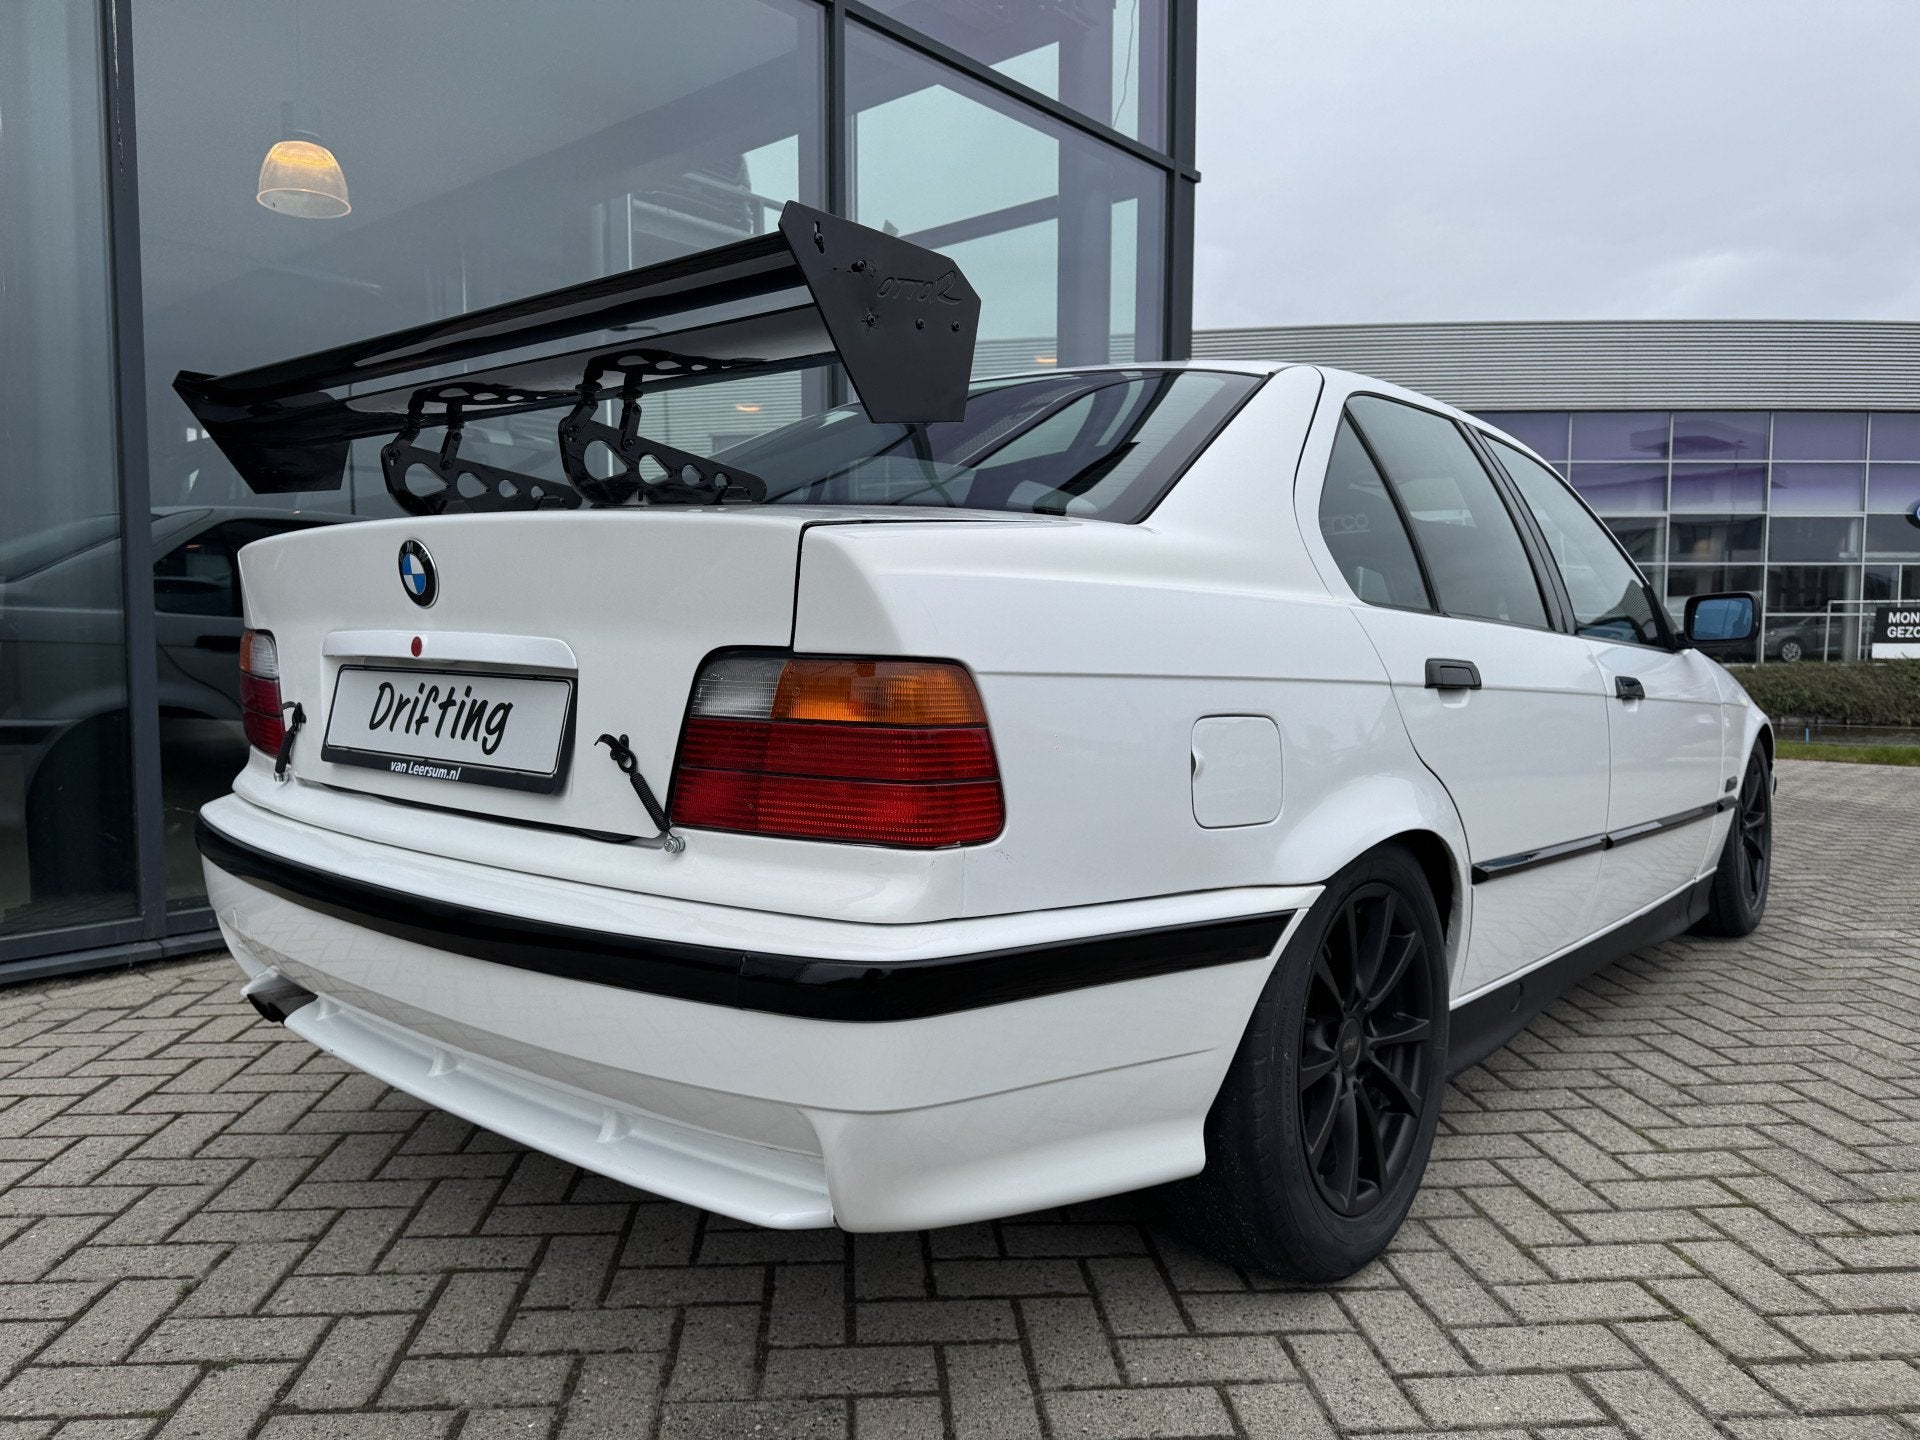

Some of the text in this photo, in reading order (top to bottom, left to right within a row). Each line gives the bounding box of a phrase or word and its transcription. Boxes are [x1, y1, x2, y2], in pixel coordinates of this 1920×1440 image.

[1888, 611, 1920, 624] MON
[369, 681, 514, 756] Drifting
[390, 761, 462, 781] van Leersum.nl
